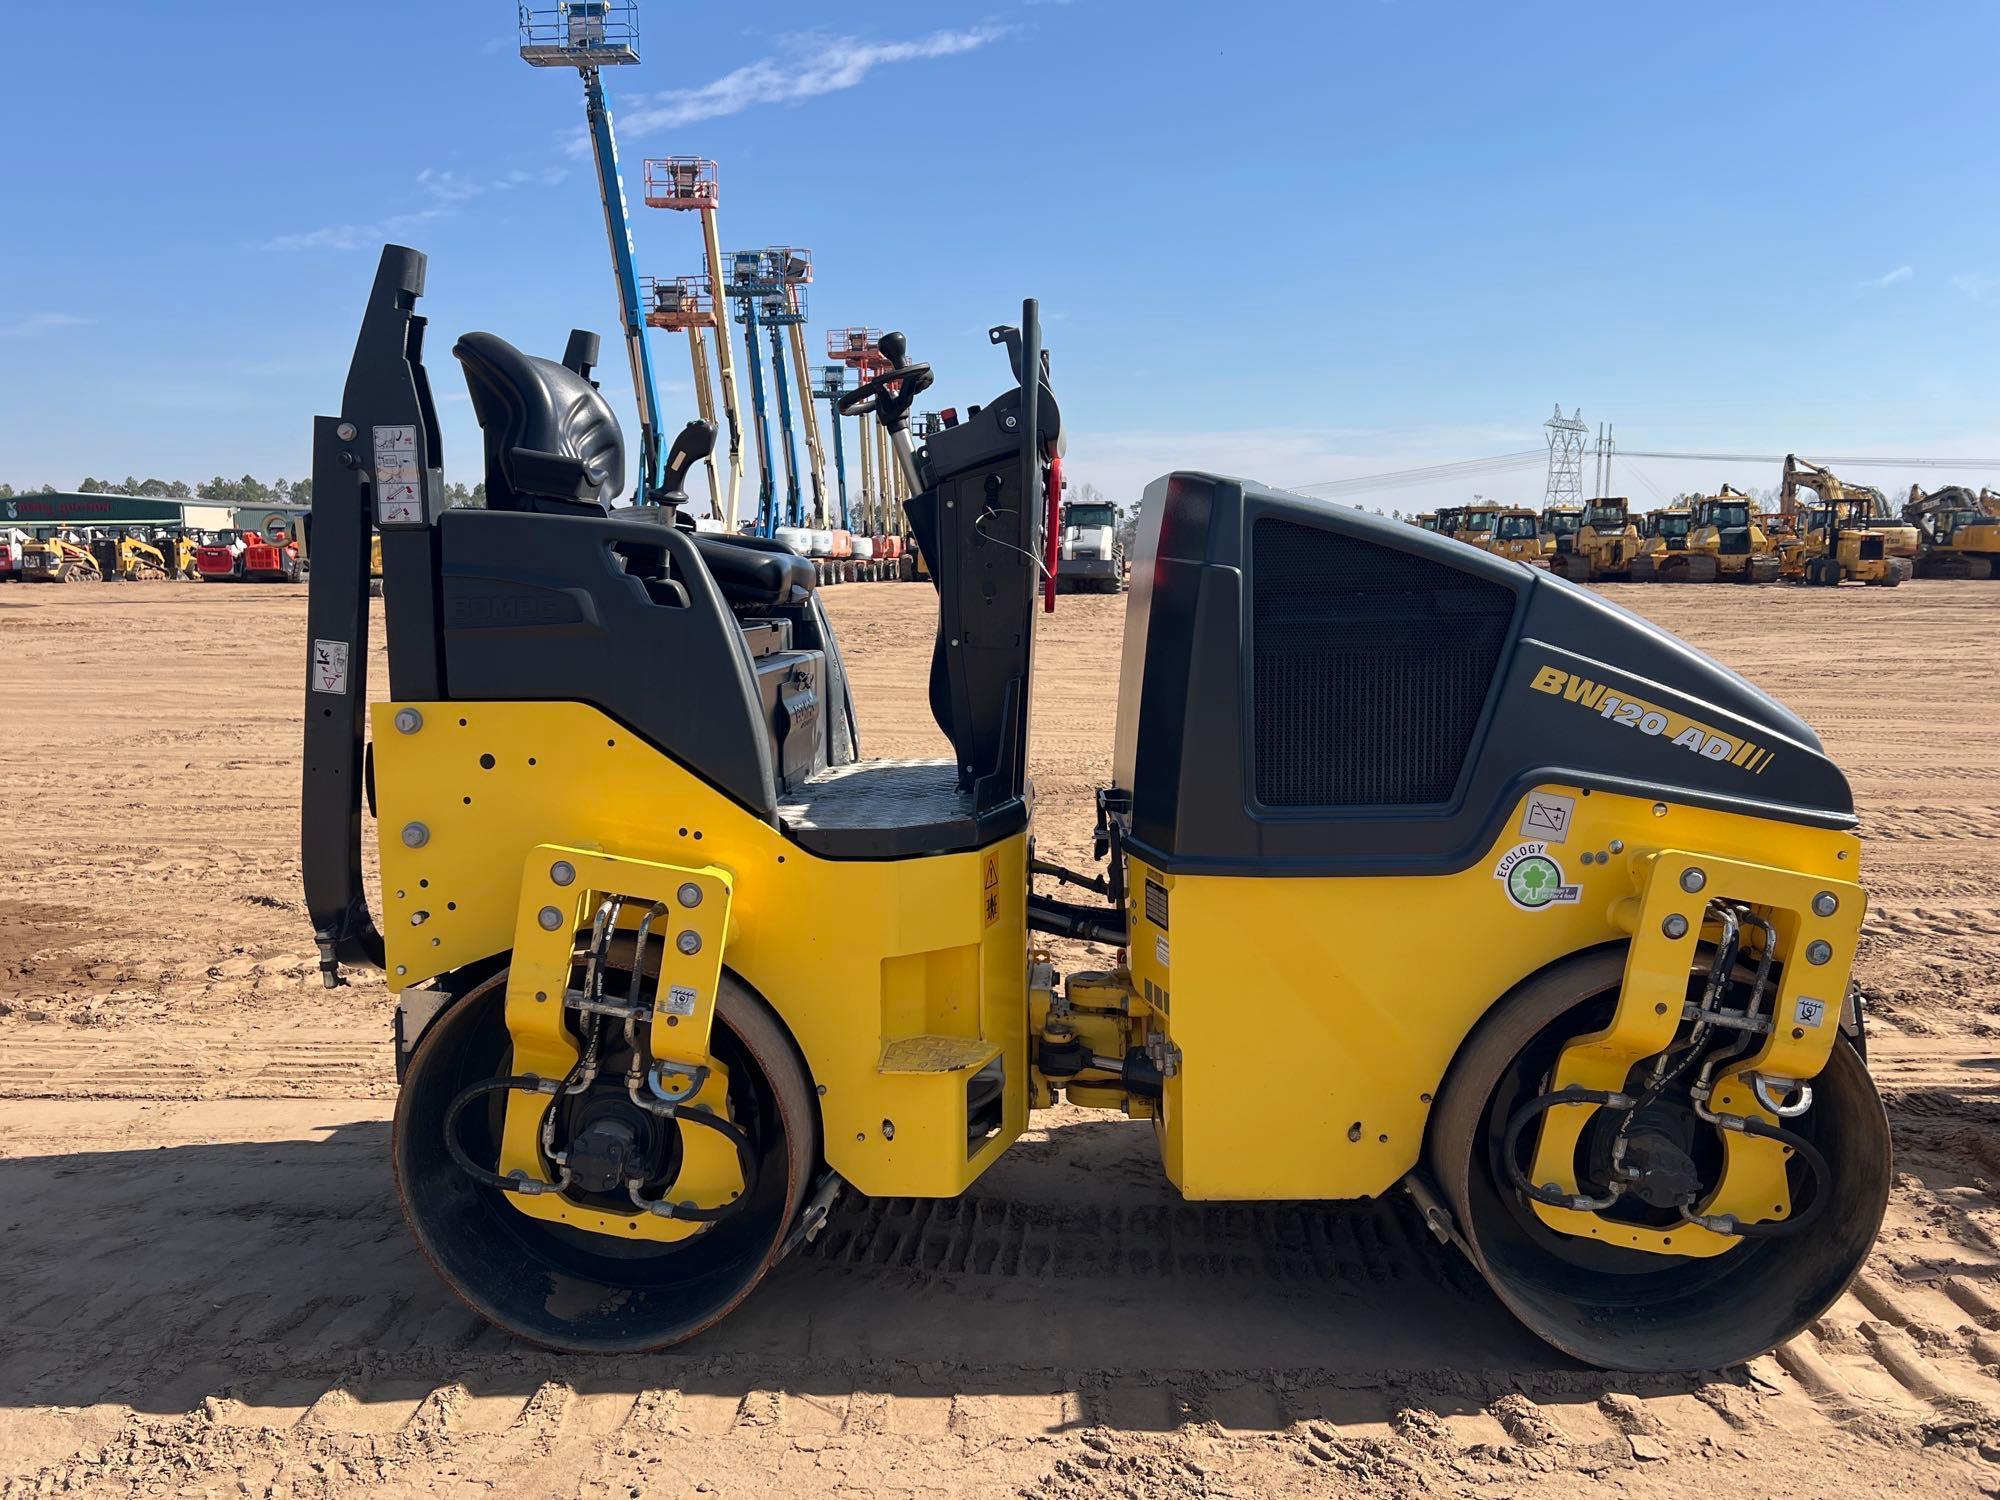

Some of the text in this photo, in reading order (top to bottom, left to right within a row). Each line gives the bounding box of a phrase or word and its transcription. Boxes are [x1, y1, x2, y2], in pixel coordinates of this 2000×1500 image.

[24, 555, 41, 568] CAT
[1671, 725, 1733, 762] AD
[1497, 844, 1544, 878] ECOLOGY
